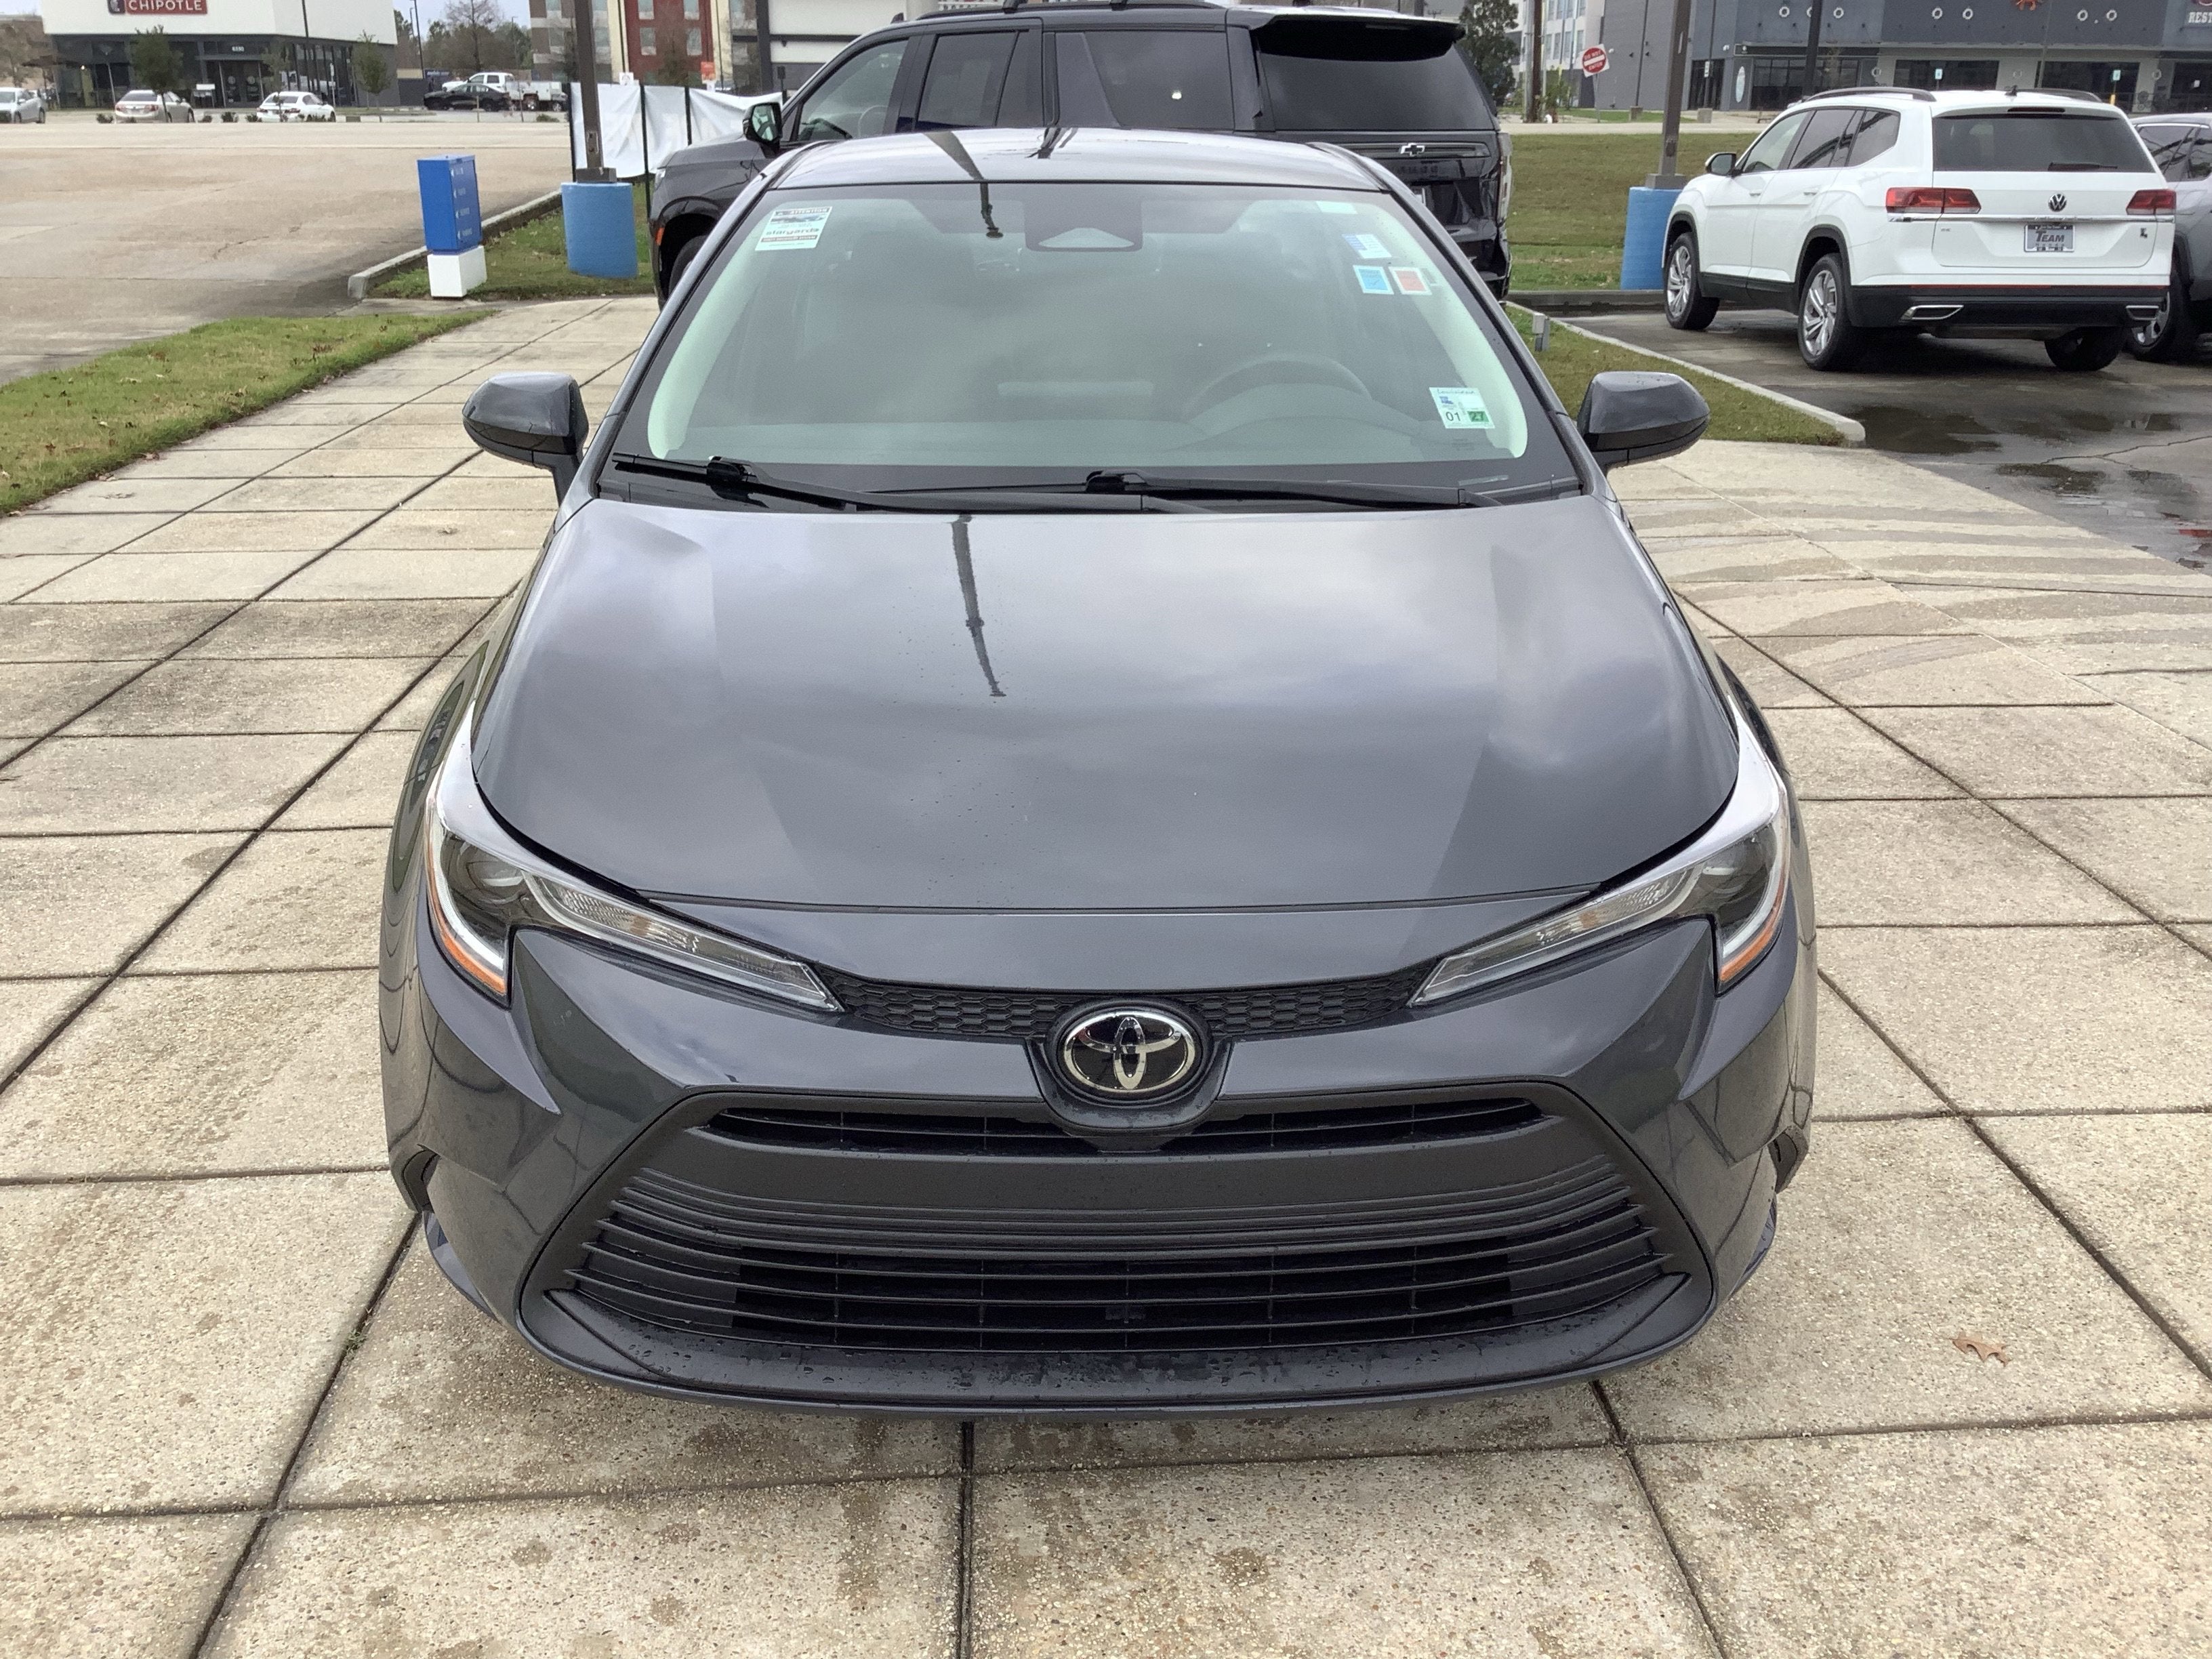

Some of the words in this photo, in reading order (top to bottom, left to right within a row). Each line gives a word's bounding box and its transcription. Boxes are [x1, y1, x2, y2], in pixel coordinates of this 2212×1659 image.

[128, 0, 203, 10] CHIPOTLE
[2036, 229, 2065, 243] TEAM
[1446, 411, 1461, 422] 01
